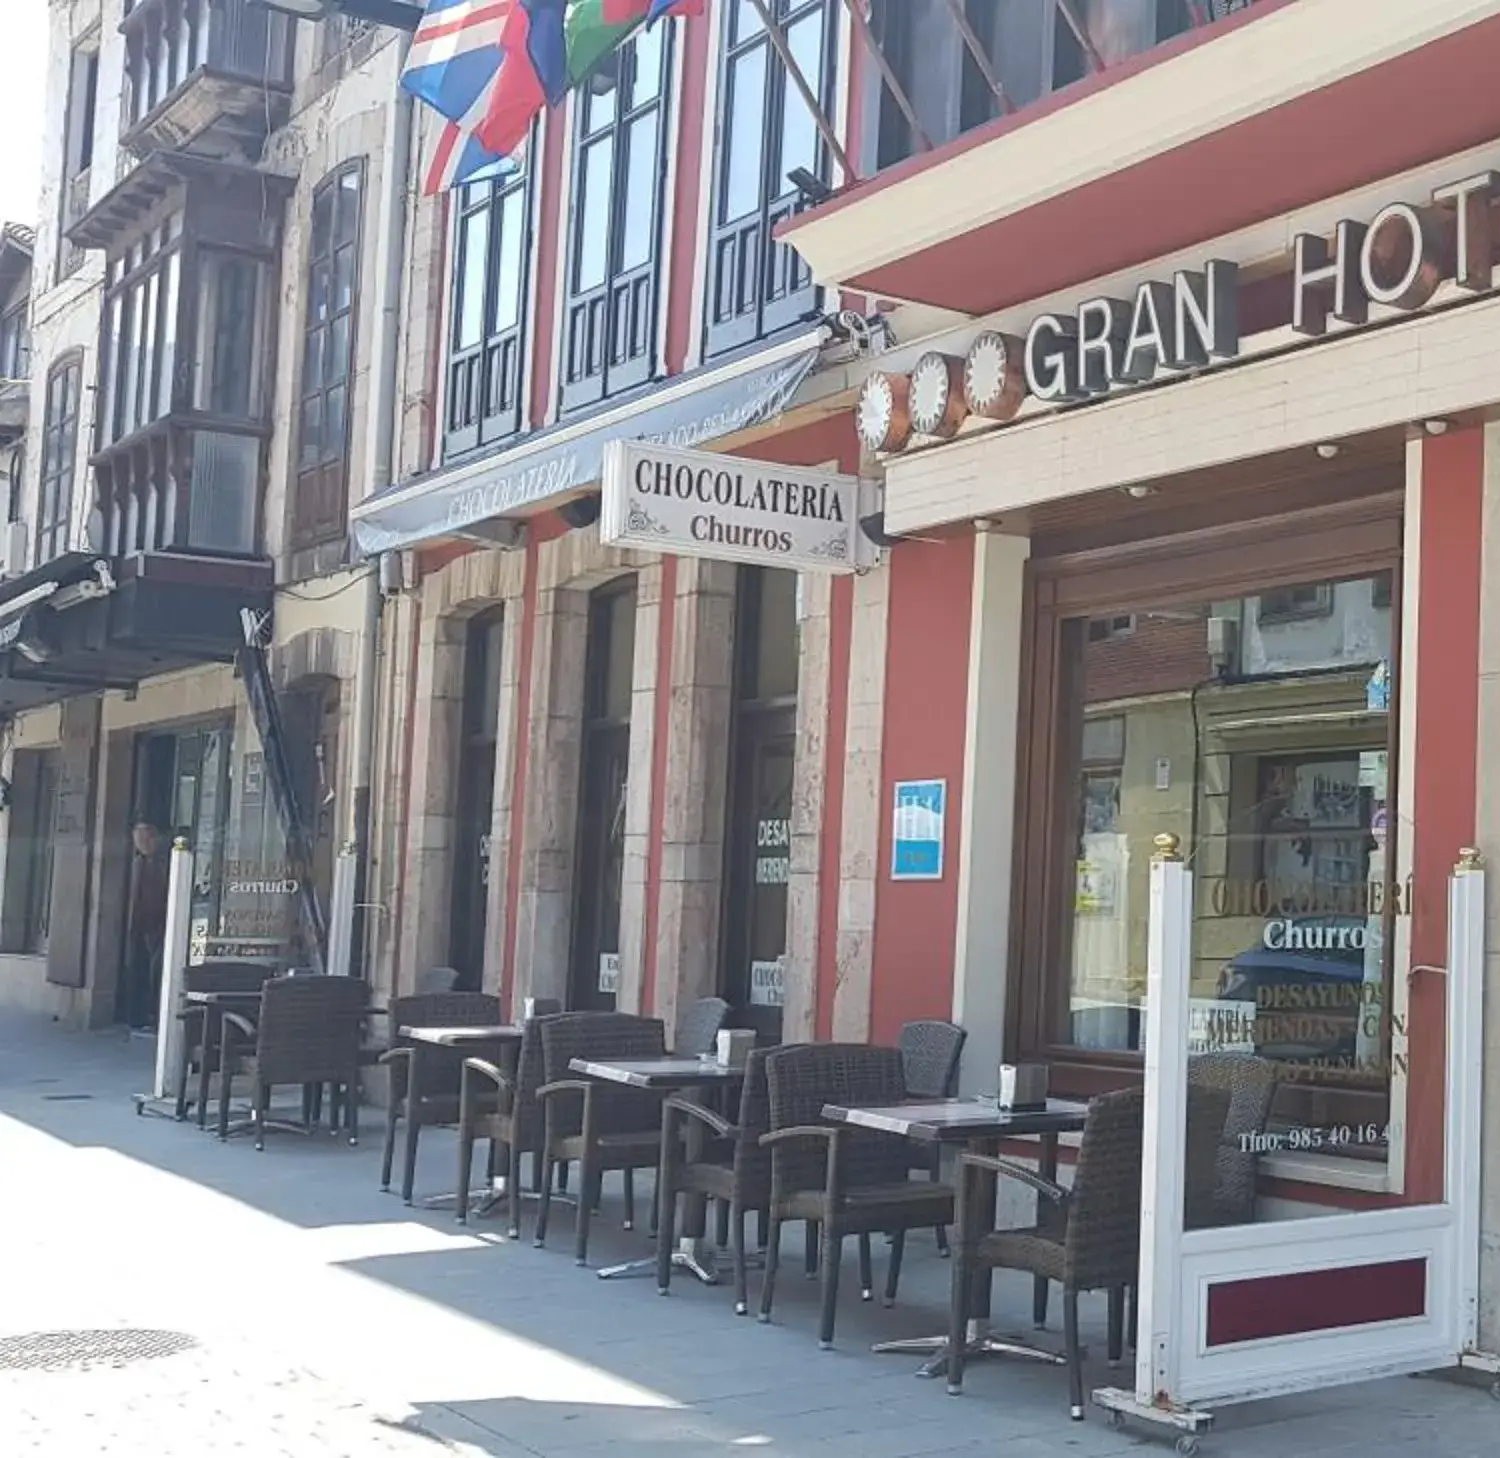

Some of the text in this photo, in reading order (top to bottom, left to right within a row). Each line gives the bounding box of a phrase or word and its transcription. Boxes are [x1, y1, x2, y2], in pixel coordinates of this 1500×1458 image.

[1024, 260, 1232, 399] GRAN
[635, 459, 844, 522] CHOCOLATERÍA
[690, 514, 792, 552] Churros
[1263, 919, 1384, 949] Churros
[1256, 981, 1384, 1009] DESAYUNOS
[1237, 1131, 1283, 1153] Tfno:
[1288, 1126, 1323, 1149] 985
[1328, 1125, 1350, 1146] 40
[1356, 1123, 1377, 1143] 16
